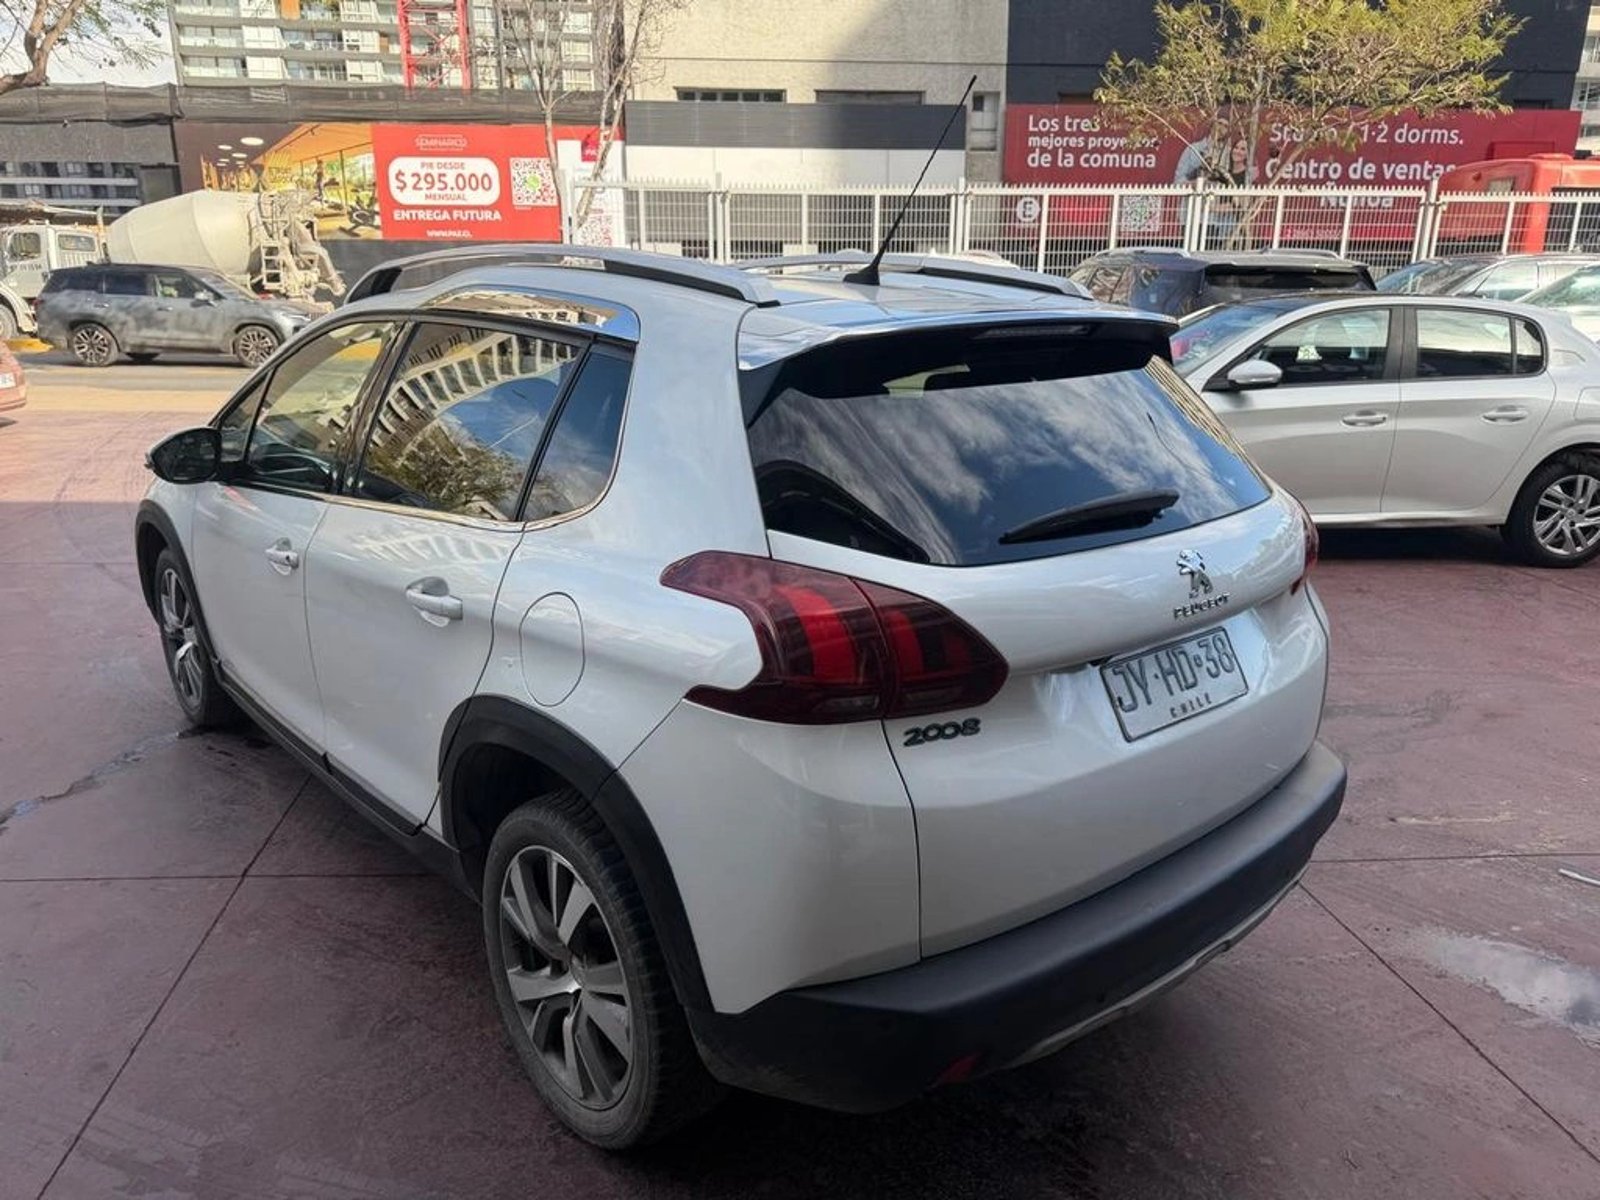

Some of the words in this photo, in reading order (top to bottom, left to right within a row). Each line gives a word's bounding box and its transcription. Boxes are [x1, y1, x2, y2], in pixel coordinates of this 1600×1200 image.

[1028, 115, 1059, 132] Los
[1064, 115, 1100, 132] tres
[1270, 122, 1338, 142] Stuo
[1394, 123, 1464, 145] dorms.
[1028, 135, 1085, 150] mejores
[1088, 135, 1159, 151] proyeo
[437, 162, 465, 170] DESDE
[1028, 152, 1052, 168] de
[1057, 151, 1075, 168] la
[1080, 154, 1156, 168] comuna
[1266, 157, 1342, 180] Centro
[1348, 157, 1377, 180] de
[425, 193, 466, 201] MENSUAL
[394, 210, 449, 221] ENTREGA
[453, 209, 502, 221] FUTURA
[1173, 593, 1231, 620] PEUGEOT
[1170, 692, 1213, 719] CHILE
[903, 717, 981, 747] 2008
